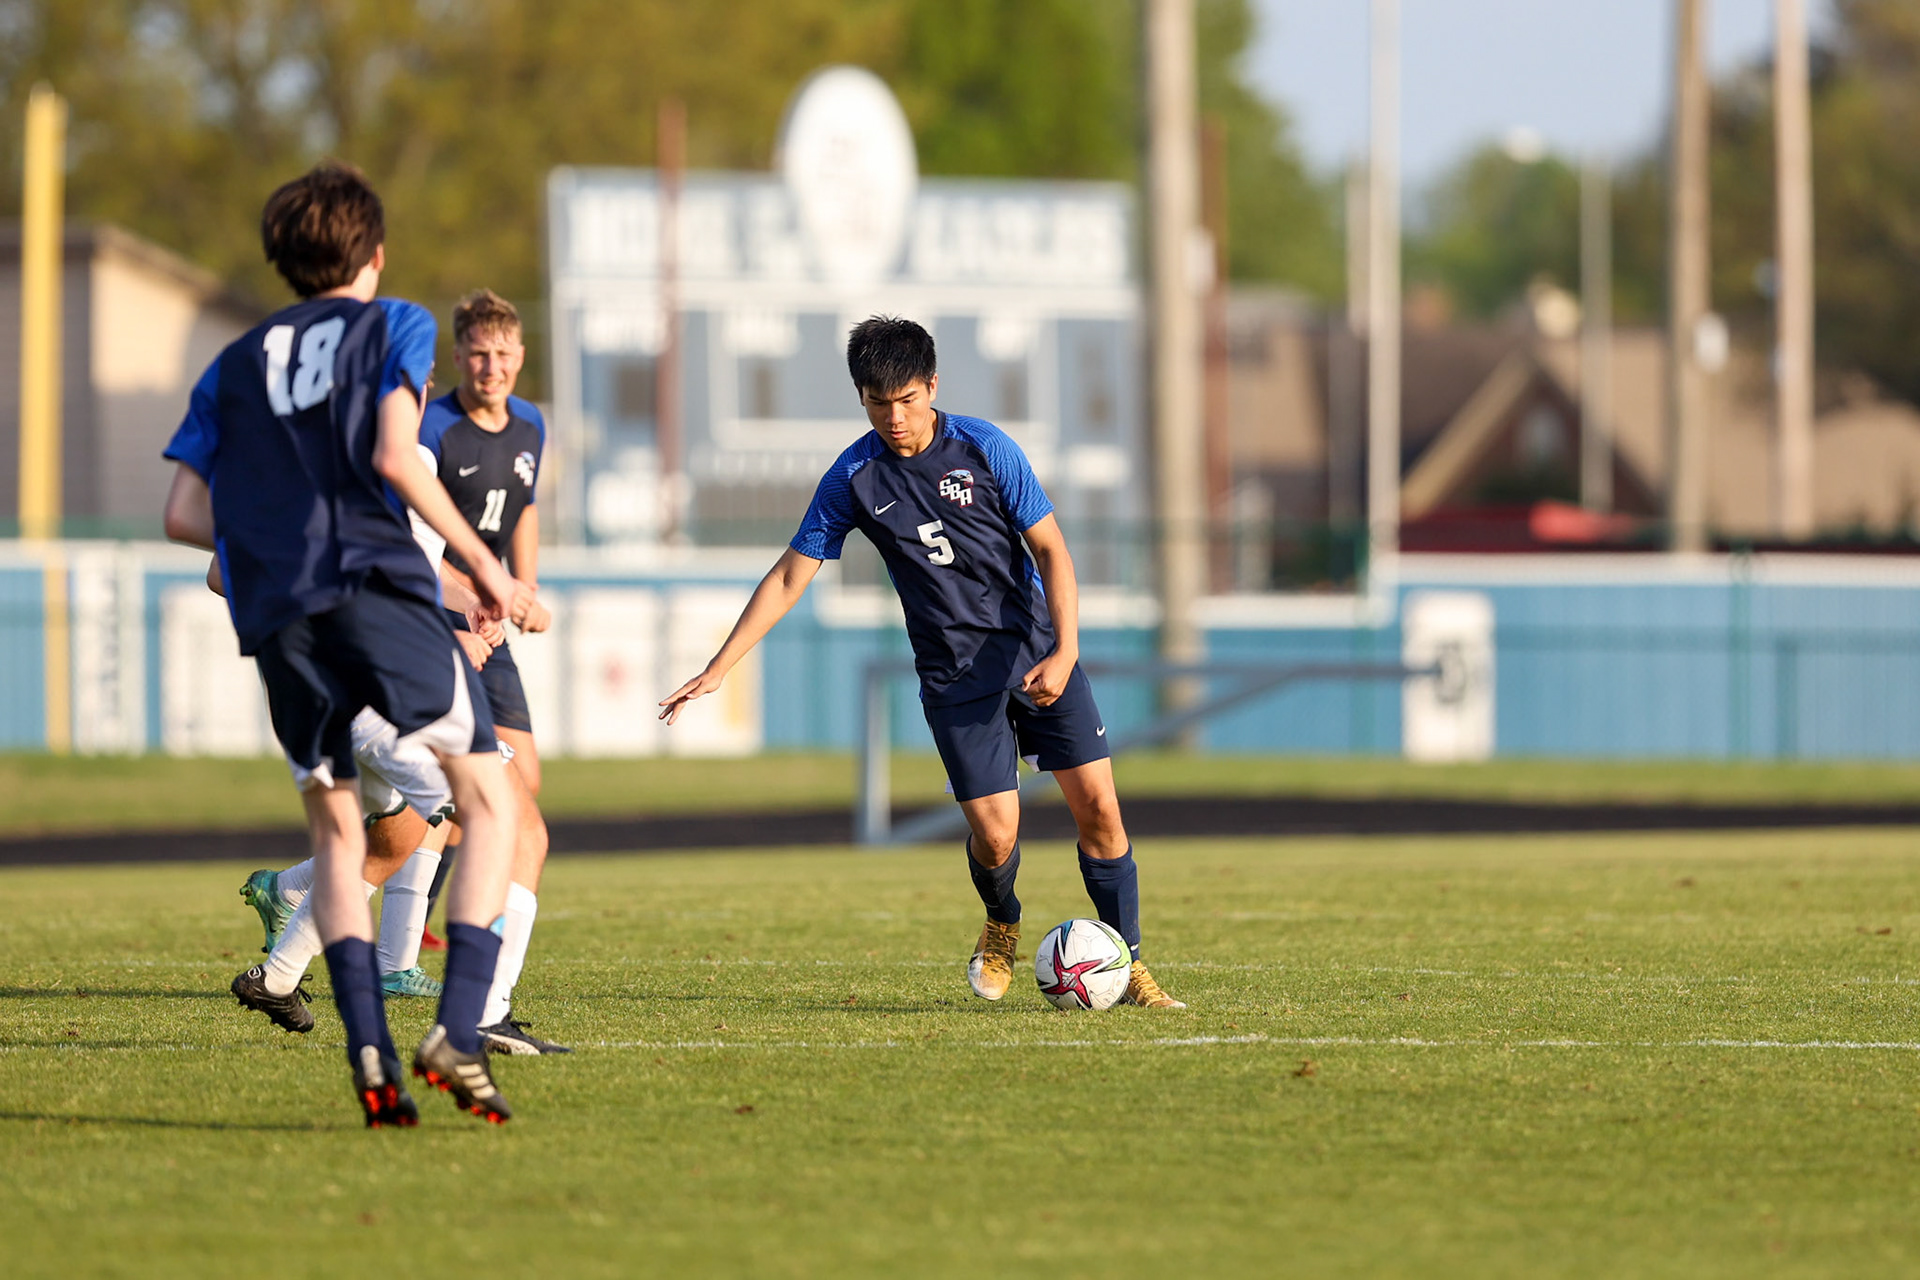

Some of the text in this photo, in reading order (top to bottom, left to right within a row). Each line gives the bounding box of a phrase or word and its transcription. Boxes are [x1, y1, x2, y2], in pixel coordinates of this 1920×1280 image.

[263, 316, 346, 416] 18
[477, 488, 508, 532] 11
[939, 478, 973, 506] SBA
[916, 519, 956, 566] 5
